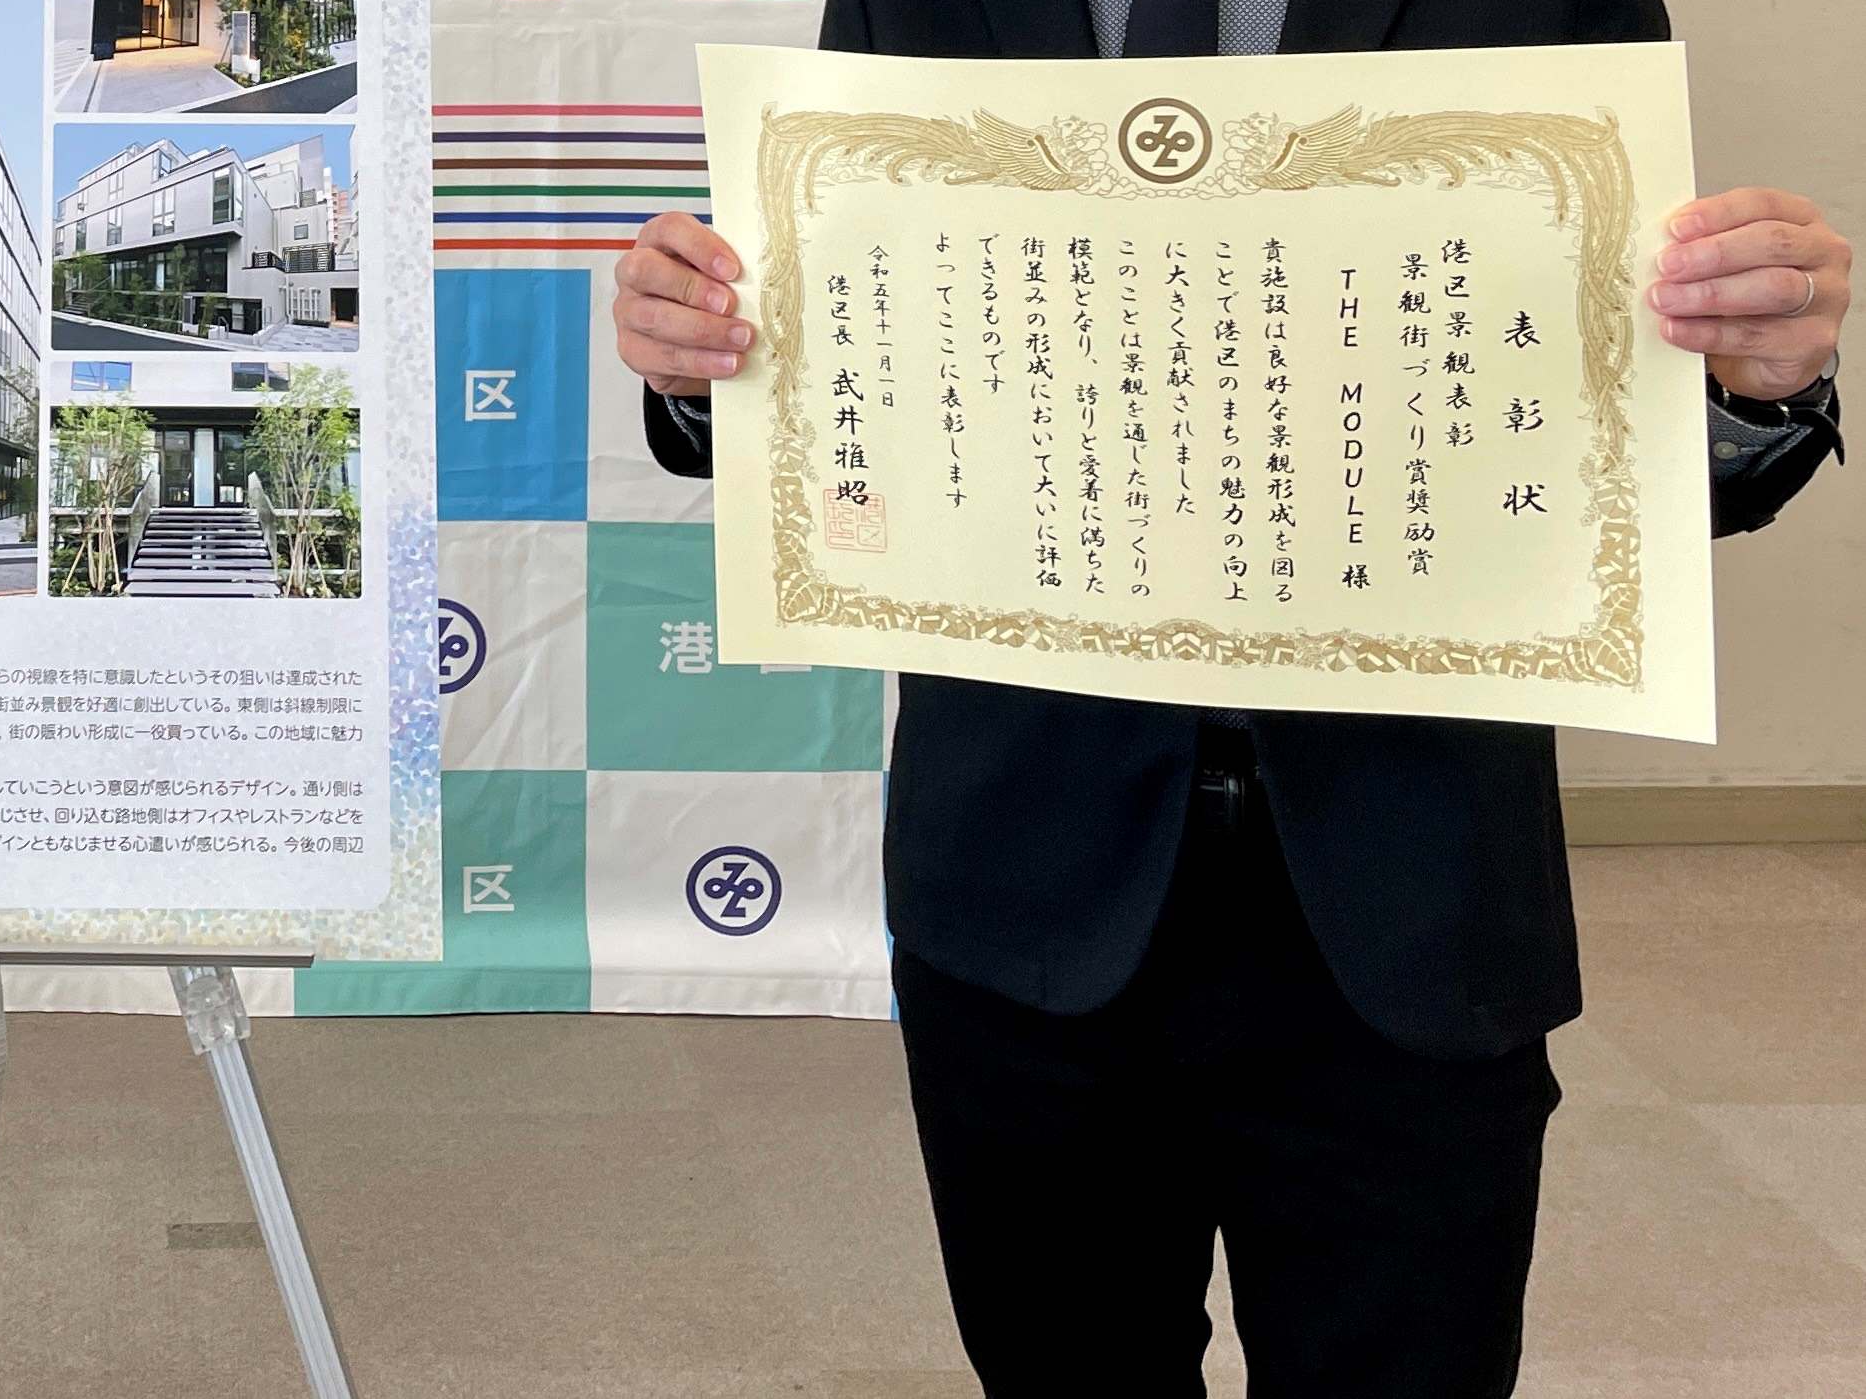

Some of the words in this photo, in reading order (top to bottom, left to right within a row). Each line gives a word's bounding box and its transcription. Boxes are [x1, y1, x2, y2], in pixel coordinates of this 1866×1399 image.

[465, 369, 517, 422] 区
[827, 274, 855, 348] 港区長
[867, 245, 895, 408] 令和五年十一月一日
[935, 232, 966, 509] よってここに表彰します
[977, 232, 1006, 395] できるものです
[1165, 241, 1196, 515] に大きく貢献されました
[1340, 268, 1360, 350] THE
[1440, 238, 1475, 448] 港区景観表彰
[830, 368, 869, 507] 武井雅昭
[1020, 237, 1063, 588] 街並みの形成において大いに評価
[1118, 238, 1151, 599] このことは景観を通じた街づくりの
[1213, 239, 1248, 602] ことで港区のまちの魅力の向上
[1260, 237, 1295, 604] 貴施設は良好な景観形成を図る
[1340, 383, 1365, 546] MODULE
[1398, 252, 1435, 576] 景観街づくり賞奨励賞
[1502, 309, 1549, 516] 表彰状
[1341, 563, 1371, 590] 様
[461, 864, 515, 913] 区
